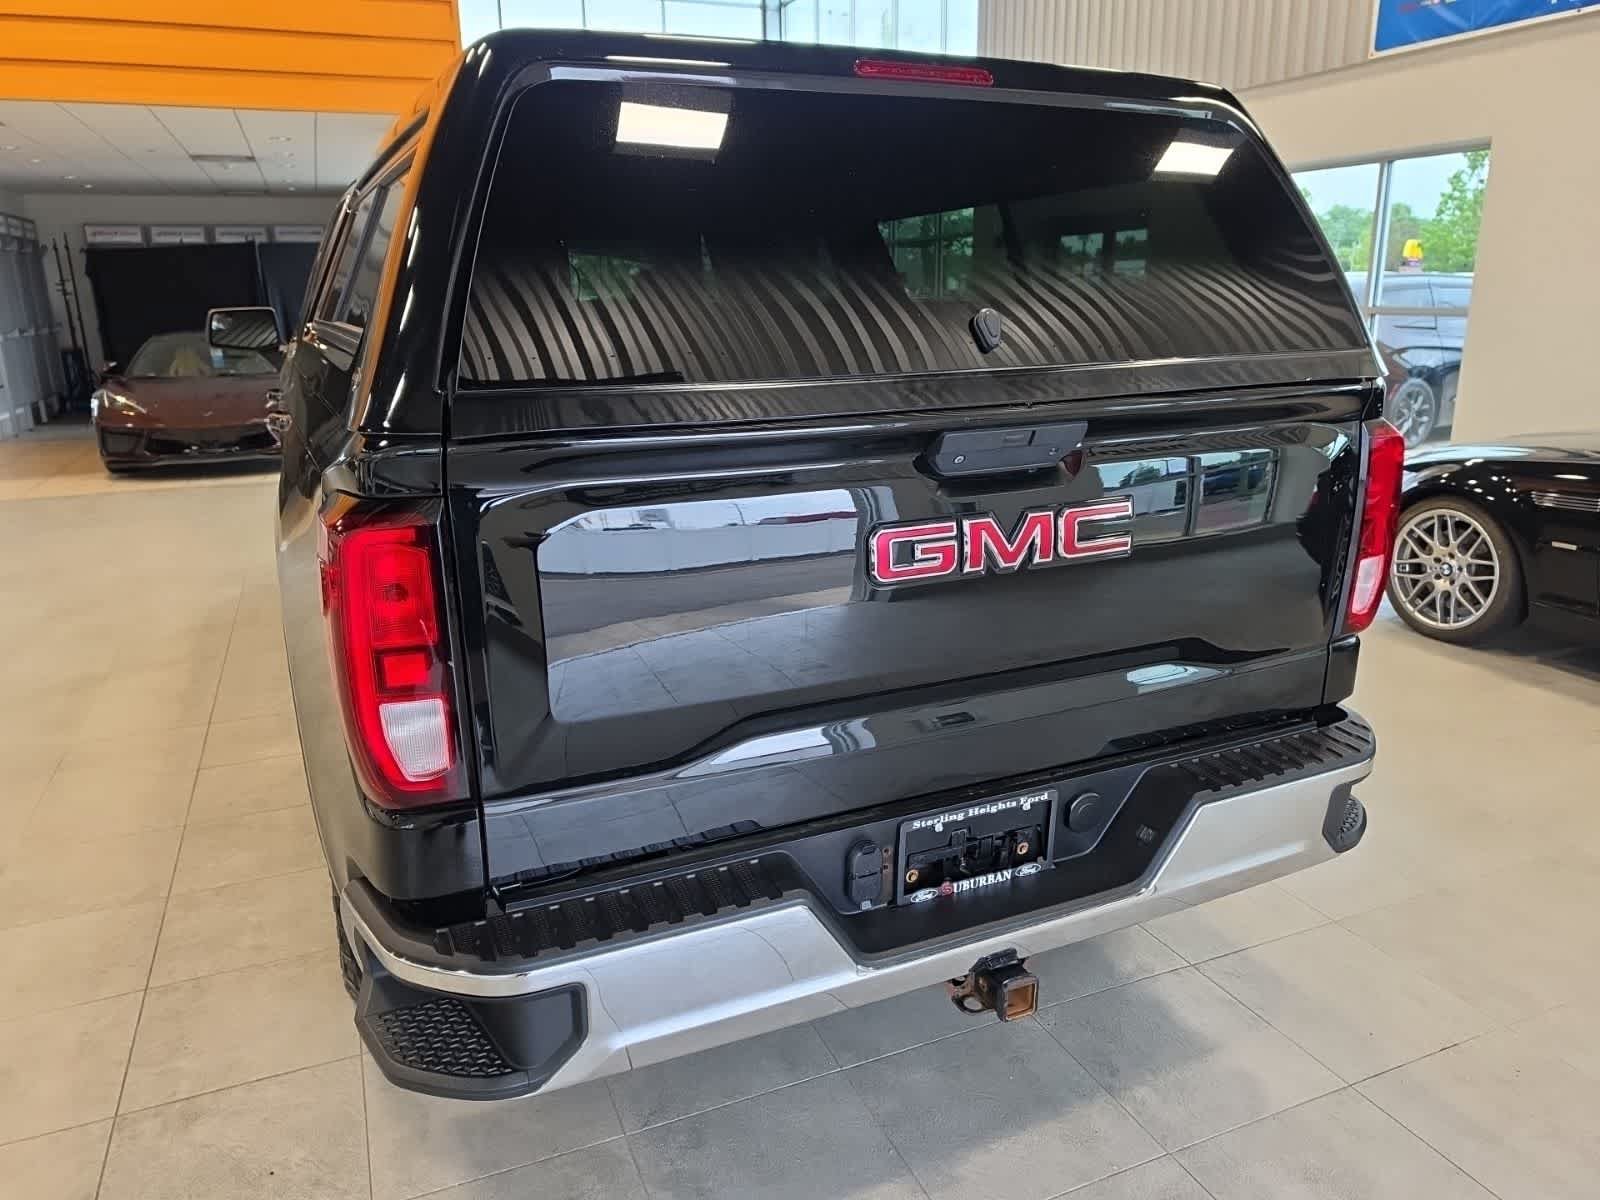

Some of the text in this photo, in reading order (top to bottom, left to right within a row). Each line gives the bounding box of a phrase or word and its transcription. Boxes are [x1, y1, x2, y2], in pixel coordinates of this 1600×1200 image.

[868, 498, 1133, 585] GMC
[912, 792, 1048, 830] Sterling Heights Ford
[941, 870, 1012, 896] SUBURBAN
[1016, 864, 1041, 877] Ford
